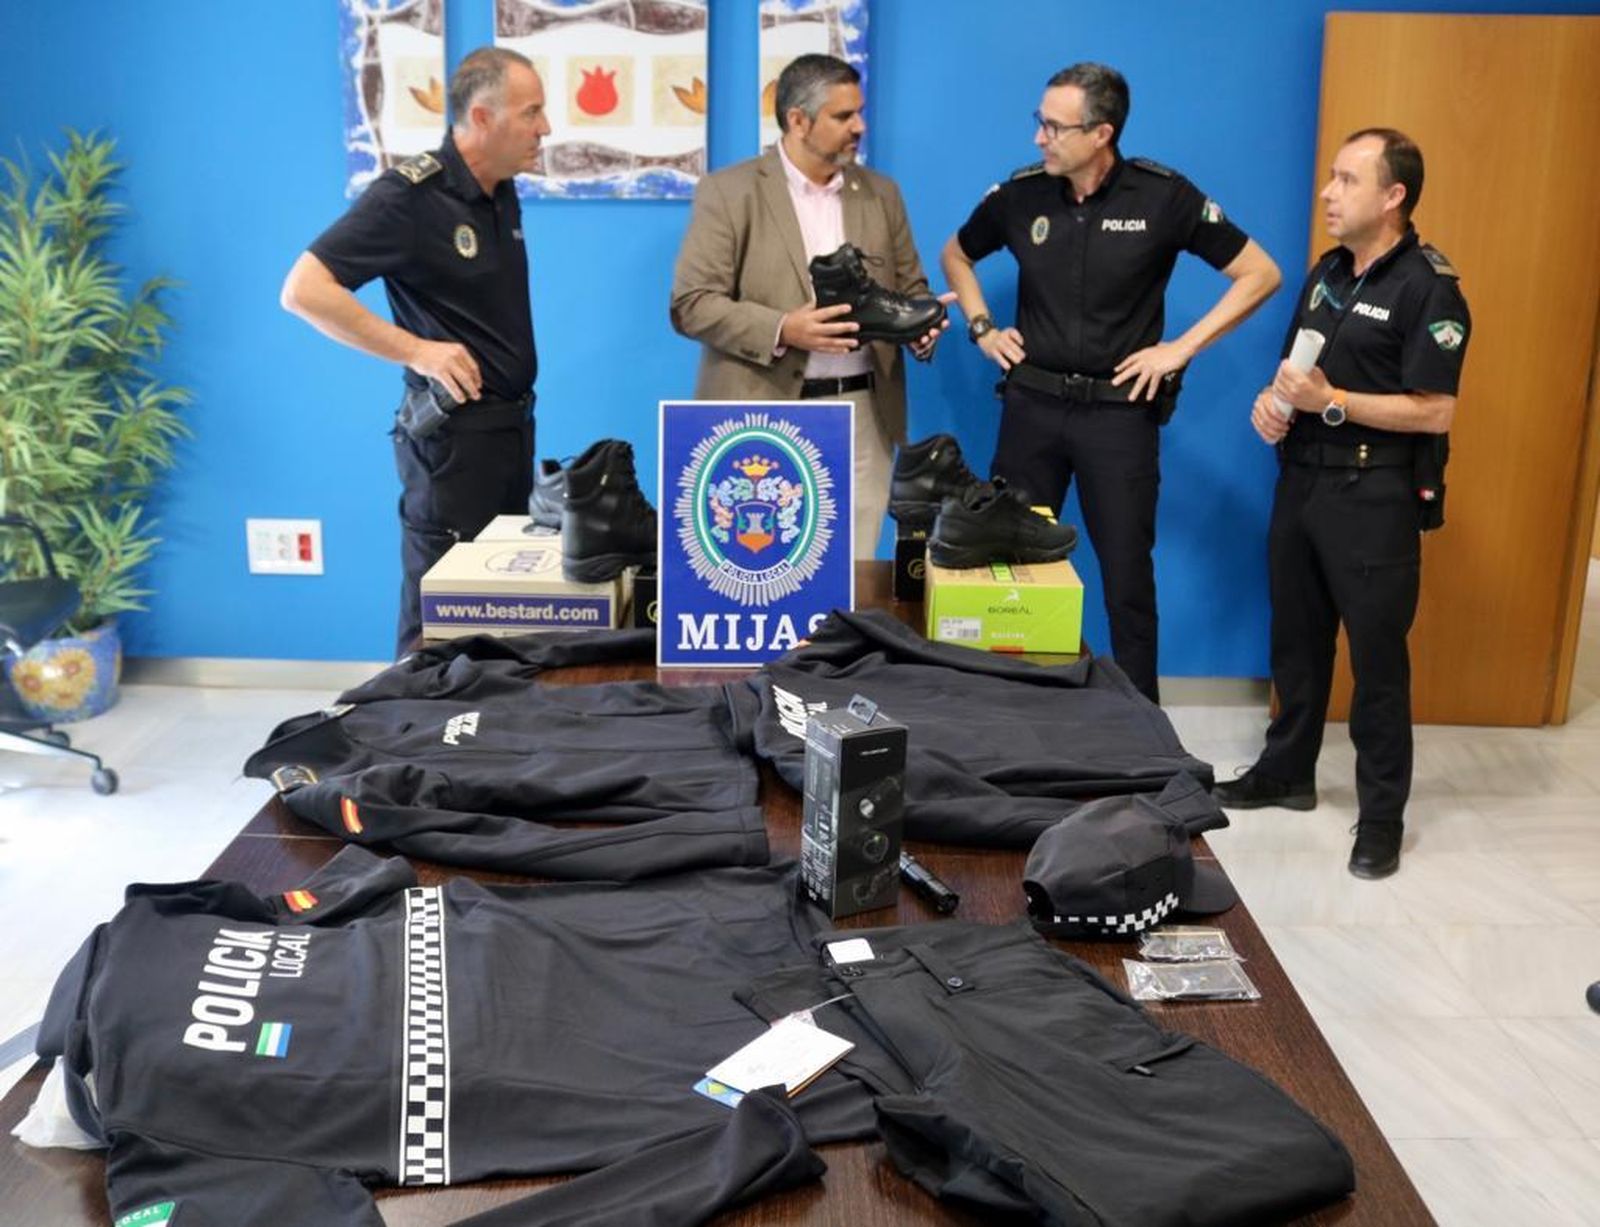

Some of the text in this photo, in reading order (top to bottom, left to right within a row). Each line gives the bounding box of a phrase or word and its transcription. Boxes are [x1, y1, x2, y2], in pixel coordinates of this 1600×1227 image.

[1101, 218, 1147, 232] POLICIA
[436, 602, 600, 621] www.bestard.com
[987, 605, 1032, 615] BOREAL
[268, 932, 312, 978] LOCAL
[182, 928, 276, 1053] POLICIA
